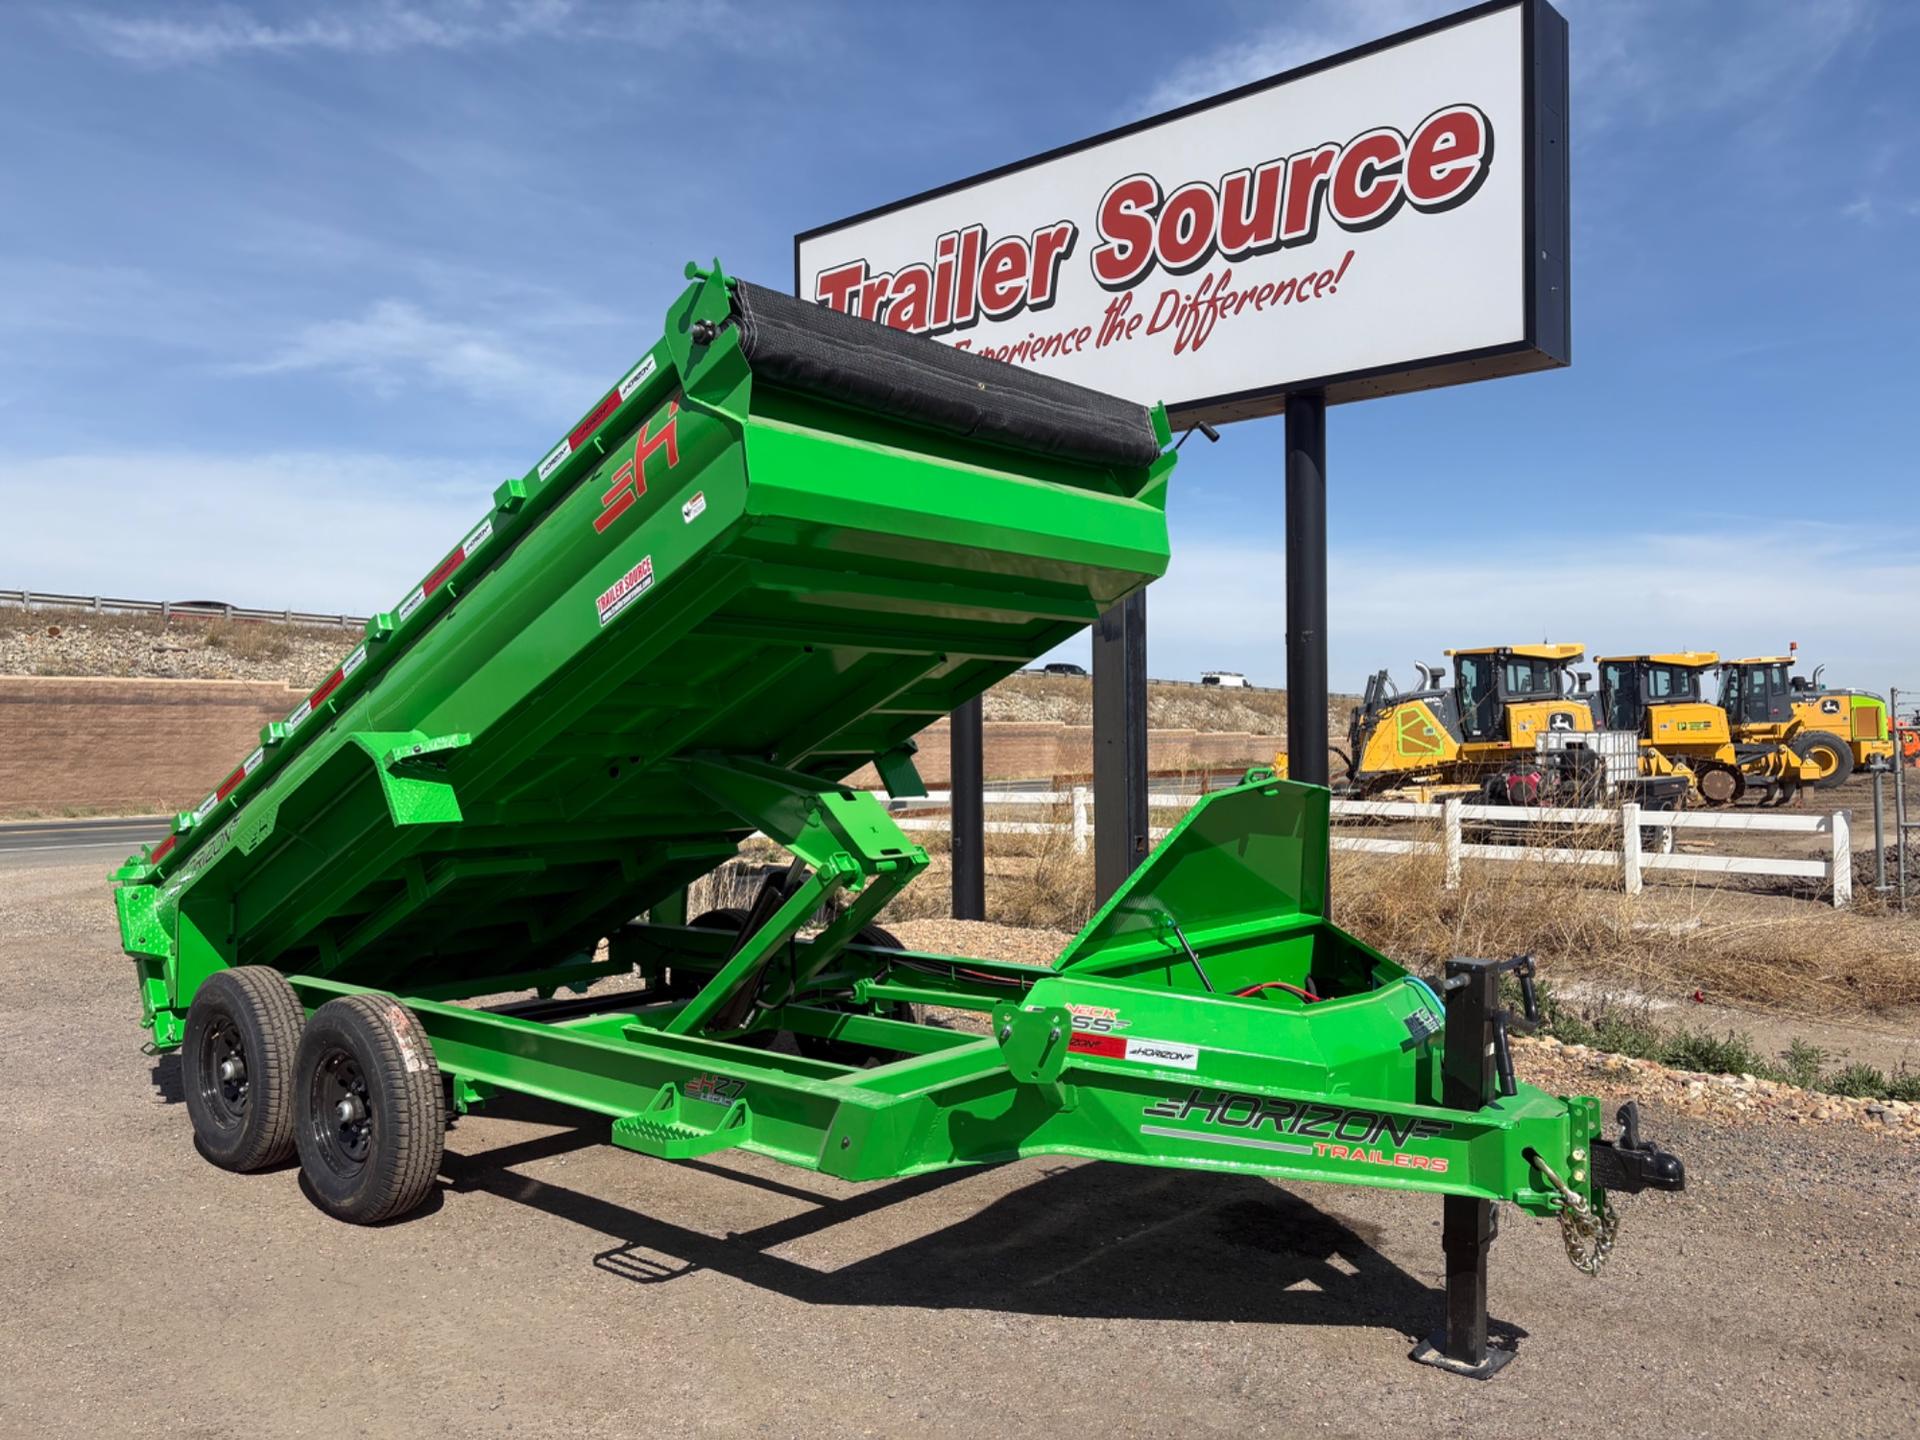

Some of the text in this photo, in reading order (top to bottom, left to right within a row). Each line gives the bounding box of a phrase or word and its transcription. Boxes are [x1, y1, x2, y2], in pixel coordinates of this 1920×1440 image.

[815, 103, 1494, 336] Trailer Source
[954, 249, 1356, 366] erience the Difference!
[597, 580, 625, 611] TRAILER
[624, 557, 652, 591] SOURCE
[1133, 1047, 1192, 1061] HORIZON
[1179, 1088, 1417, 1147] HORIZON
[1312, 1142, 1449, 1172] TRAILERS
